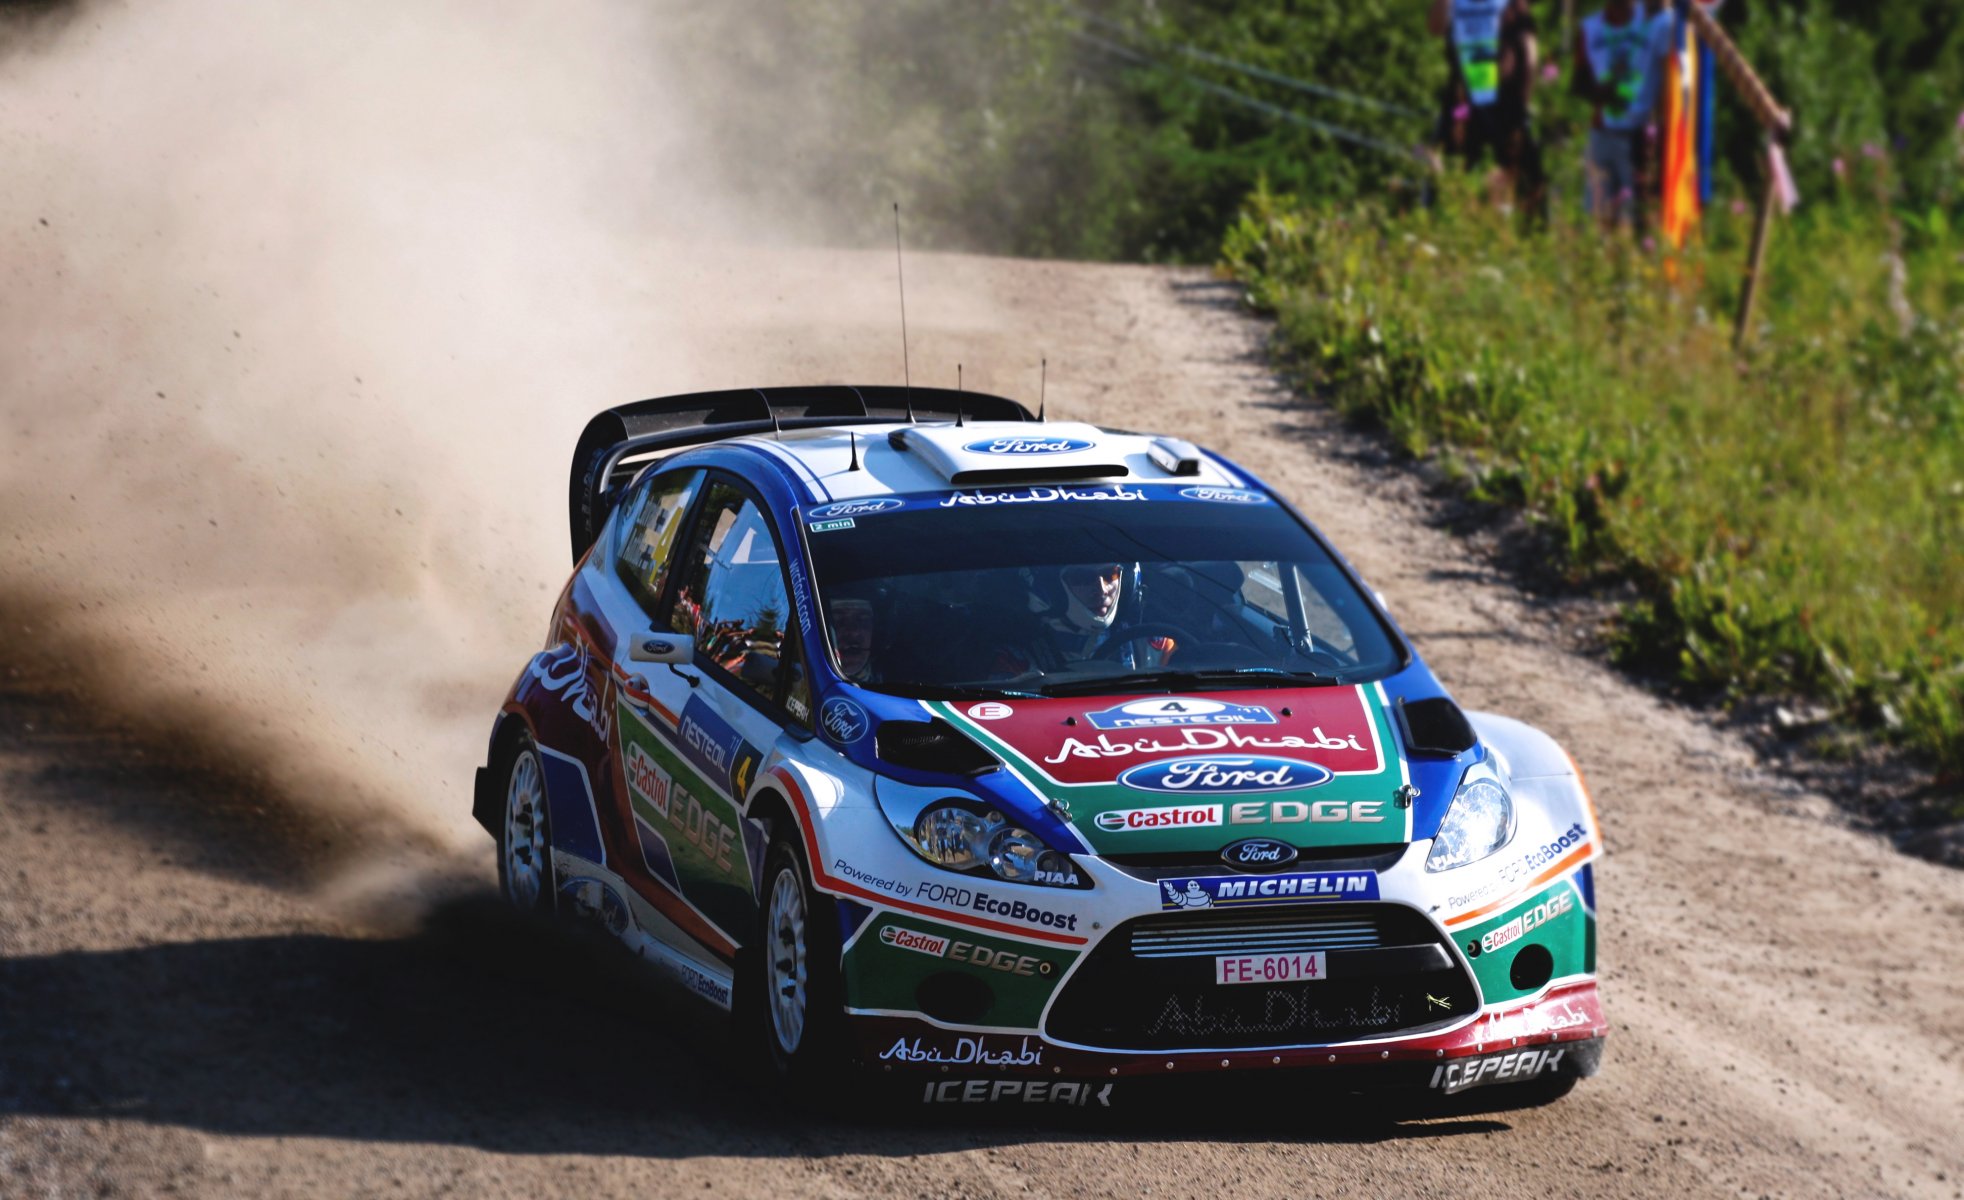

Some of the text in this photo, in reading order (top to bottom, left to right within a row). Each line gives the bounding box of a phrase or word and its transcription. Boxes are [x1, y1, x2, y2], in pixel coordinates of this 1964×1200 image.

[988, 437, 1072, 453] Ford
[1196, 487, 1250, 502] Ford
[826, 500, 886, 516] Ford
[815, 520, 852, 531] 2 min
[647, 642, 667, 653] Ford
[979, 706, 1001, 717] E
[1159, 702, 1188, 713] 4
[1216, 714, 1257, 723] OIL
[825, 701, 861, 740] Ford
[737, 756, 752, 799] 4
[1161, 758, 1293, 790] Ford
[636, 754, 736, 872] Castrol EDGE
[1127, 801, 1386, 828] Castrol EDGE
[1238, 843, 1281, 863] Ford
[834, 859, 893, 890] Powered
[895, 880, 912, 897] by
[1033, 870, 1079, 886] PIAA
[1217, 876, 1368, 898] MICHELIN
[1493, 889, 1574, 948] Castrol EDGE
[895, 930, 1041, 976] Castrol EDGE
[1223, 954, 1318, 983] FE-6014
[1429, 1048, 1566, 1089] ICEPEAK
[923, 1080, 1114, 1107] ICEPEAK
